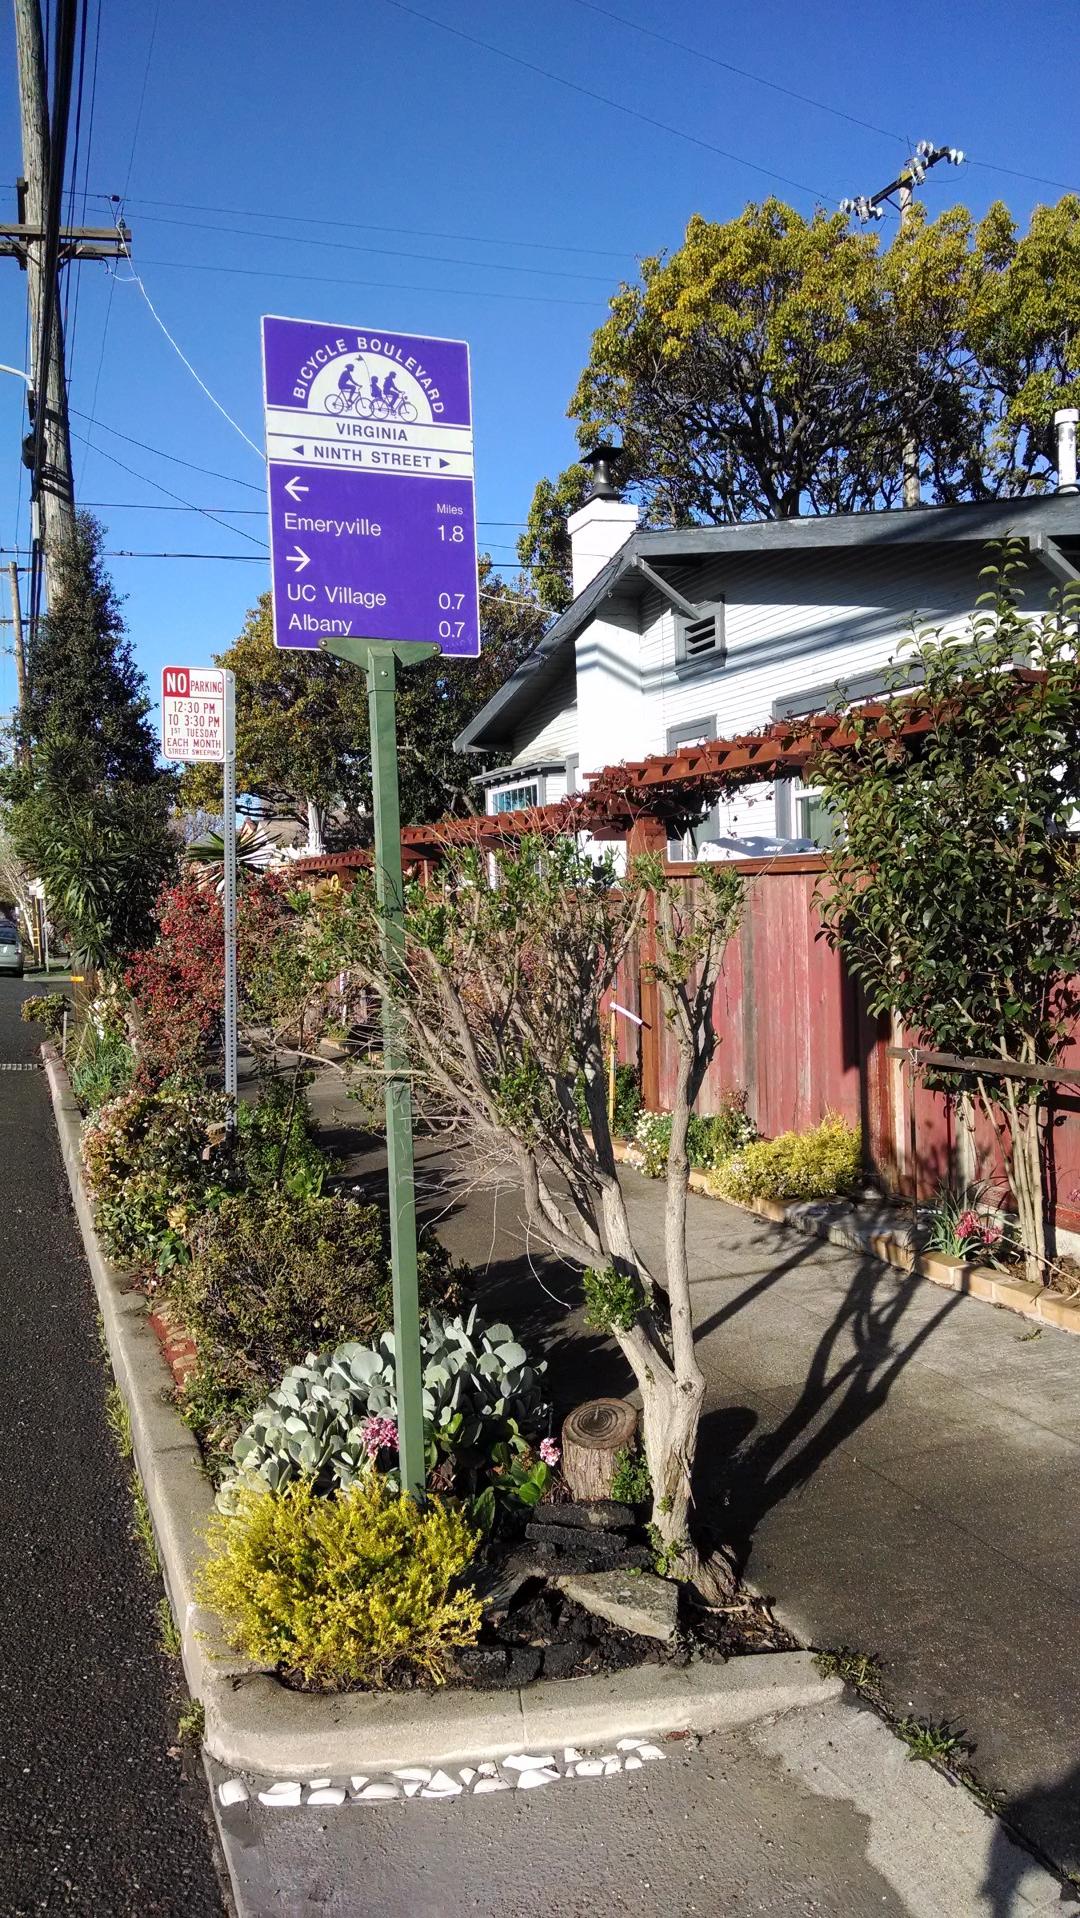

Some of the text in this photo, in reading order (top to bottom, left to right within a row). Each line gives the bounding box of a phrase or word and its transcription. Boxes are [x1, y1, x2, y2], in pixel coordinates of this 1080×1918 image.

[292, 336, 445, 414] BICYCLE BOULEVARD
[336, 422, 408, 441] VIRGINIA
[313, 445, 431, 468] NINTH STREET
[436, 503, 464, 515] Miles
[284, 512, 465, 543] Emeryville 1.8
[287, 583, 466, 610] UC Village 0.7
[288, 613, 466, 638] Albany 0.7
[166, 672, 223, 693] NO PARKING
[174, 701, 215, 714] 12:30 PM
[168, 714, 220, 727] TO 3:30 PM
[187, 728, 218, 738] TUESDAY
[167, 738, 221, 749] EACH MONTH
[191, 749, 220, 757] SWEEPING
